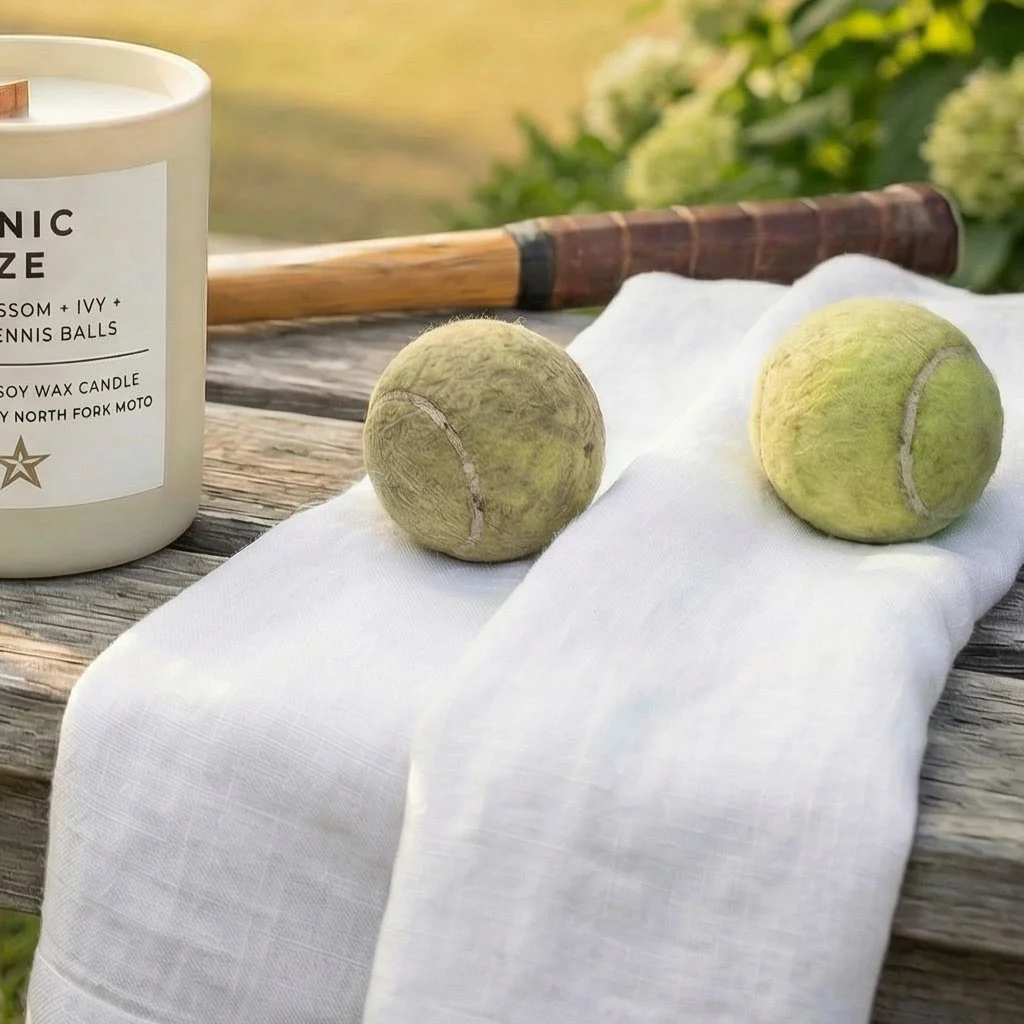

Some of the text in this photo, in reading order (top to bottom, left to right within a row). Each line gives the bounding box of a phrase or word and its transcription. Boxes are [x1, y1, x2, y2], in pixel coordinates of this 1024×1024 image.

[77, 297, 106, 315] IVY
[61, 321, 117, 342] BALLS
[35, 383, 73, 398] WAX
[79, 373, 140, 395] CANDLE
[15, 408, 66, 423] NORTH
[73, 403, 111, 420] FORK
[116, 396, 153, 414] MOTO
